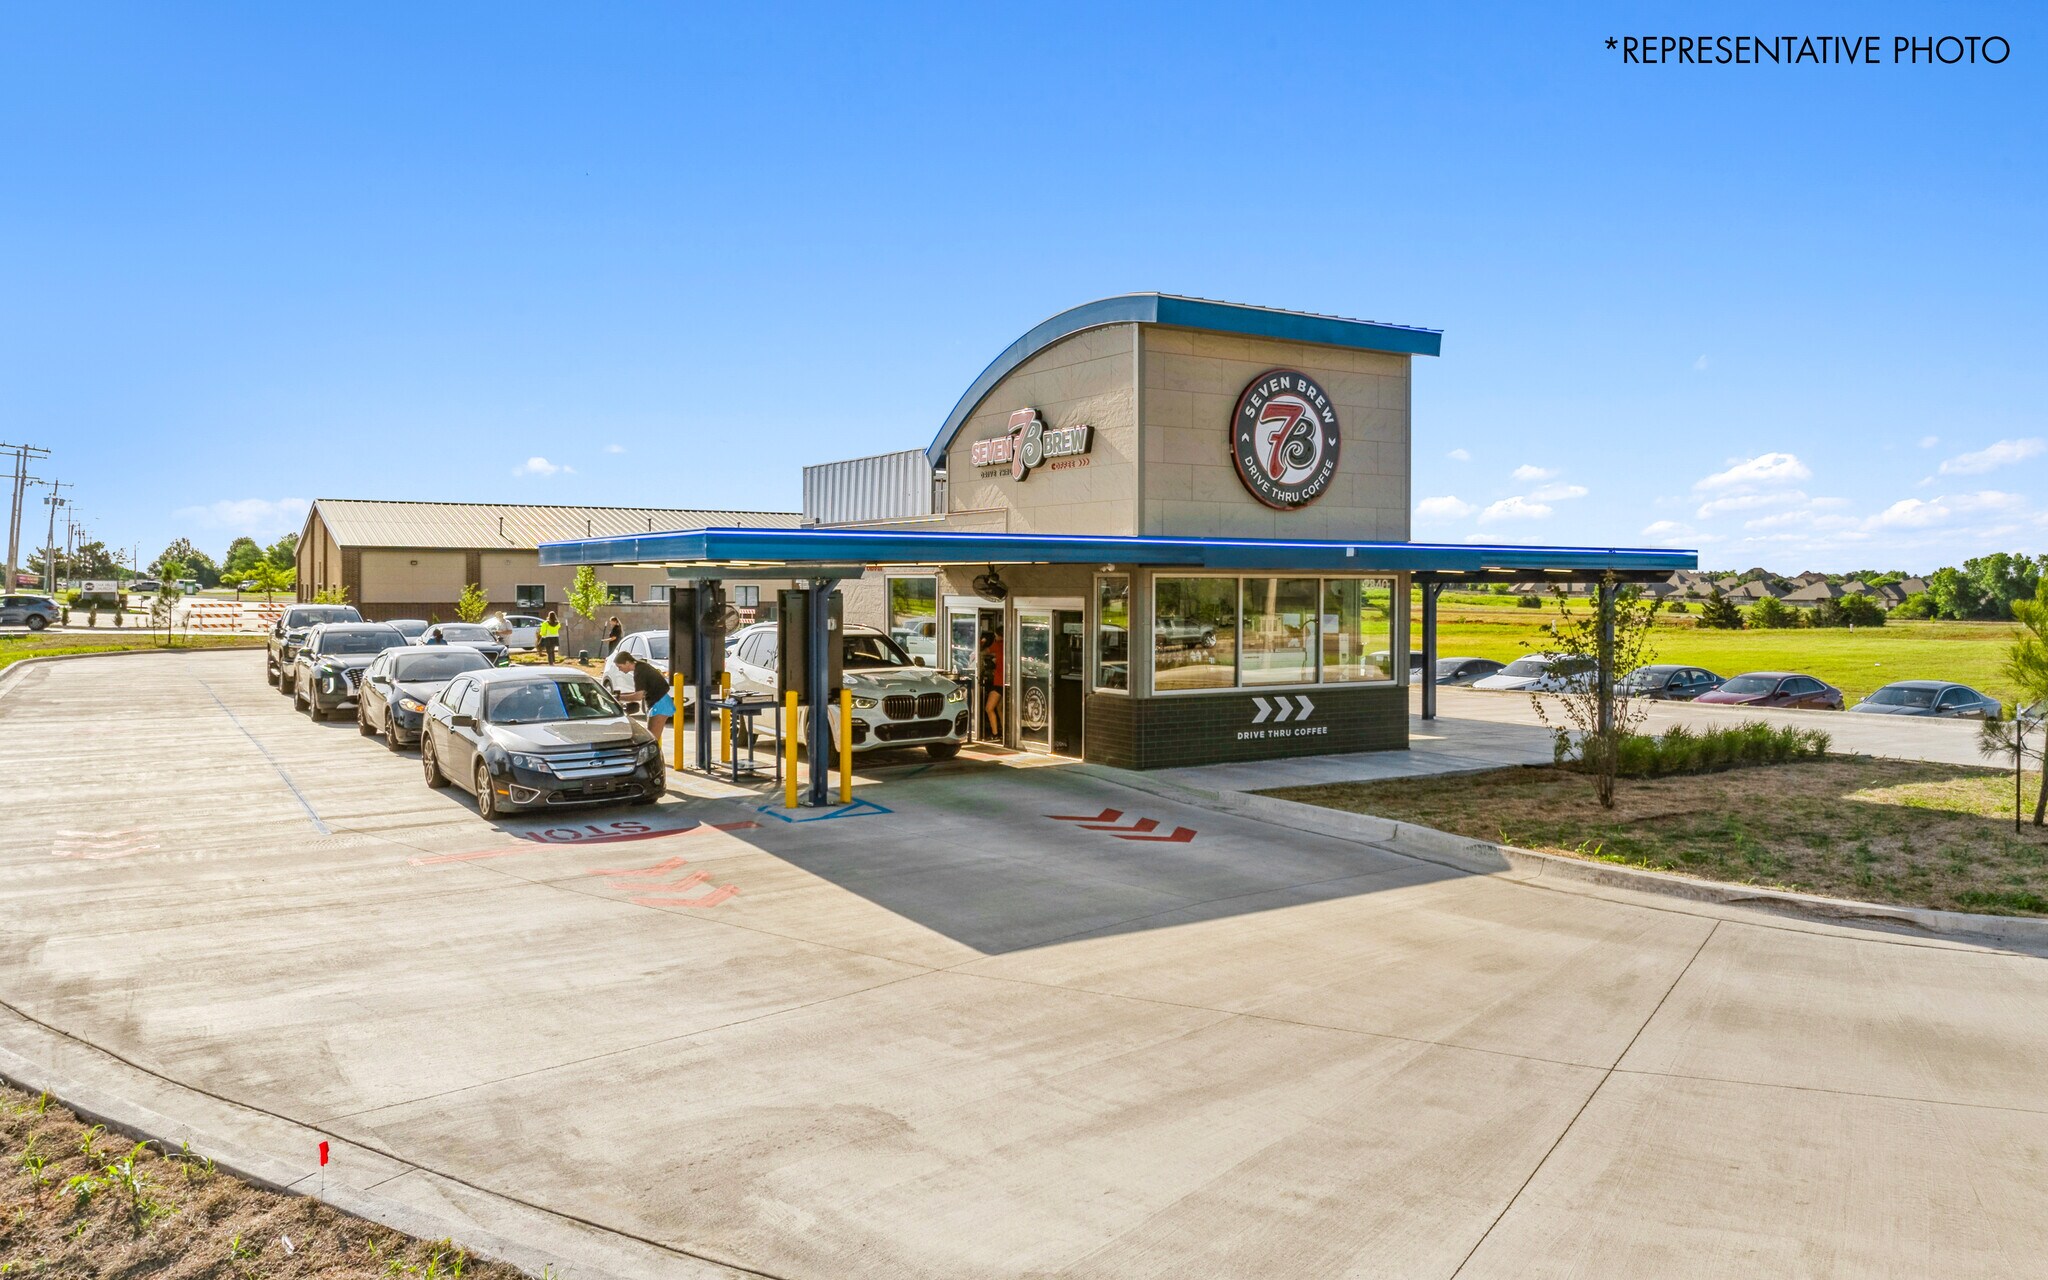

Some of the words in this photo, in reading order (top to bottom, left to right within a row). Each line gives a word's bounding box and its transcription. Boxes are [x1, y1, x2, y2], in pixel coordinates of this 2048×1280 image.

[1245, 376, 1291, 418] SEVEN
[1297, 379, 1334, 424] BREW
[971, 436, 1013, 467] SEVEN
[1043, 425, 1088, 458] BREW
[1244, 456, 1269, 493] DRIVE
[1271, 487, 1300, 502] THRU
[1301, 459, 1334, 499] COFFEE
[1237, 730, 1265, 740] DRIVE
[1268, 729, 1292, 738] THRU
[1294, 726, 1328, 736] COFFEE
